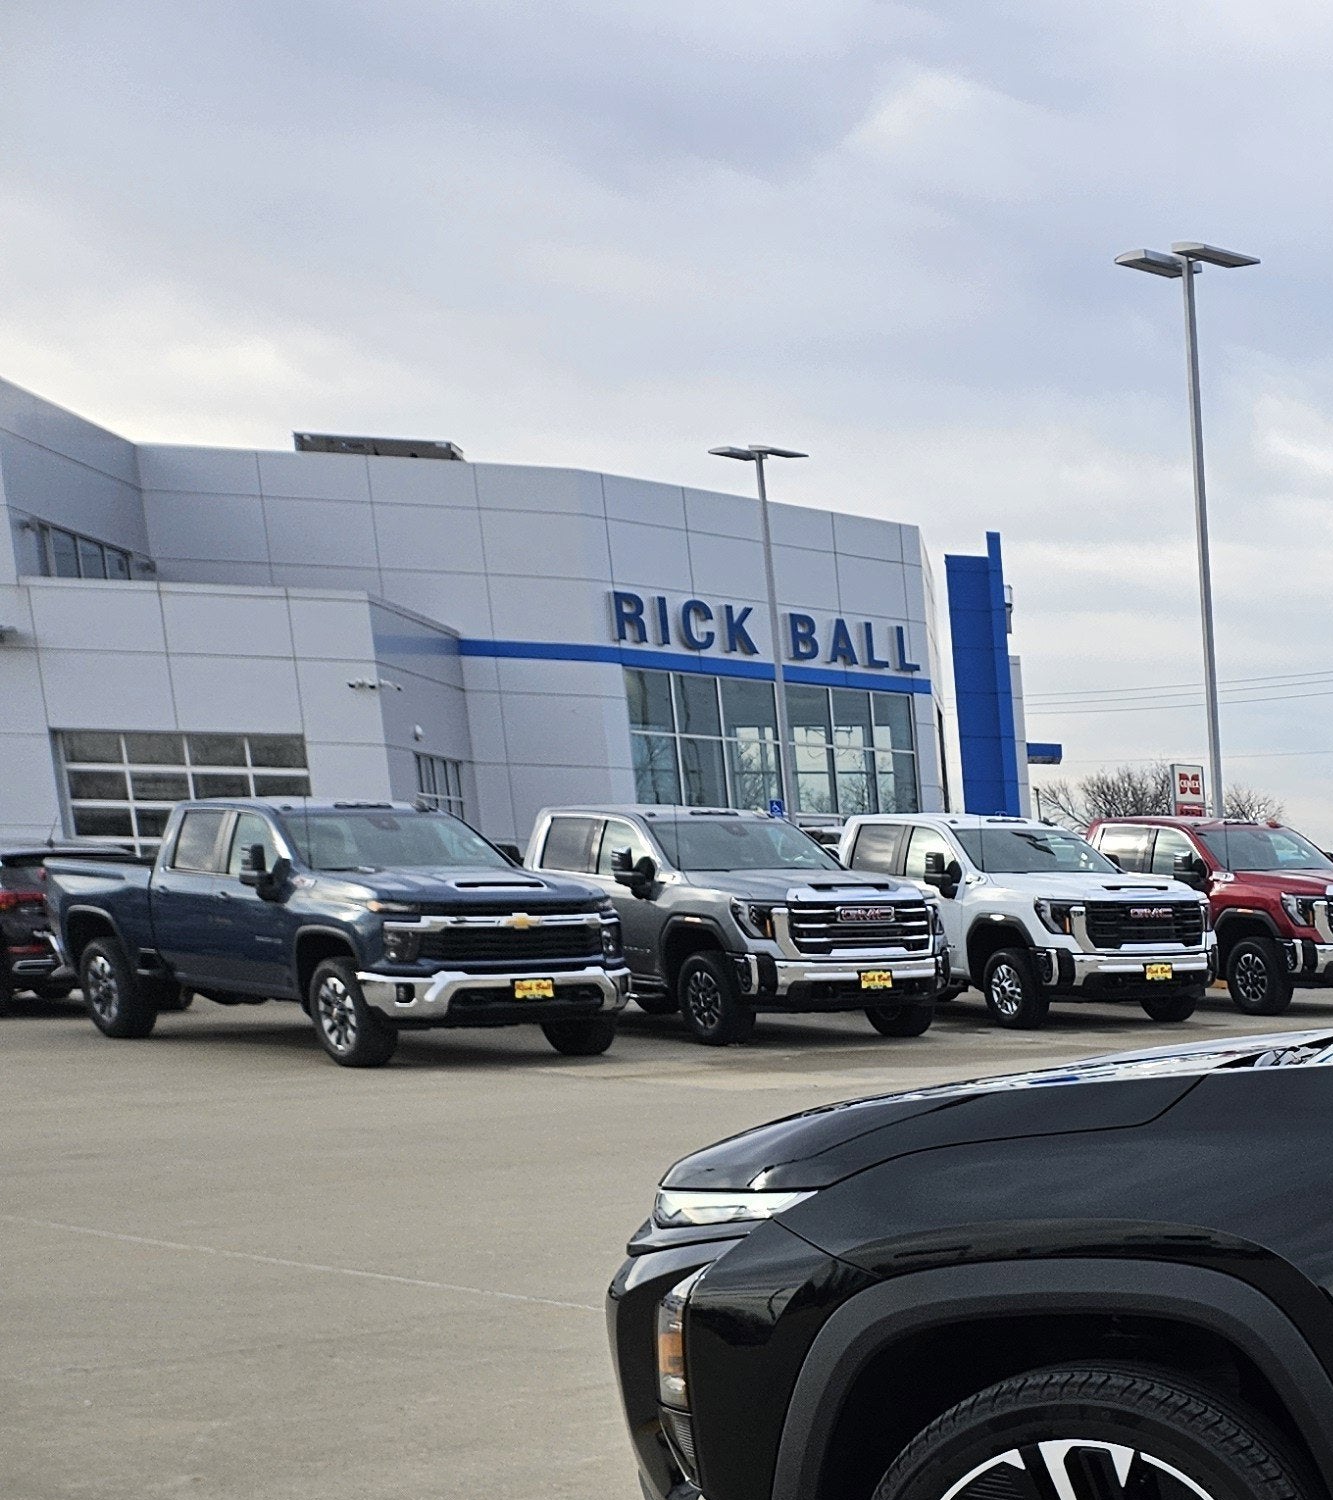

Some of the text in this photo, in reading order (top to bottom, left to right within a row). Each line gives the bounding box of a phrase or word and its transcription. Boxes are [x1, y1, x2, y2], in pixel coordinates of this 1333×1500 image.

[606, 590, 921, 671] RICK BALL
[841, 908, 893, 921] GMC
[1130, 907, 1173, 919] GMC
